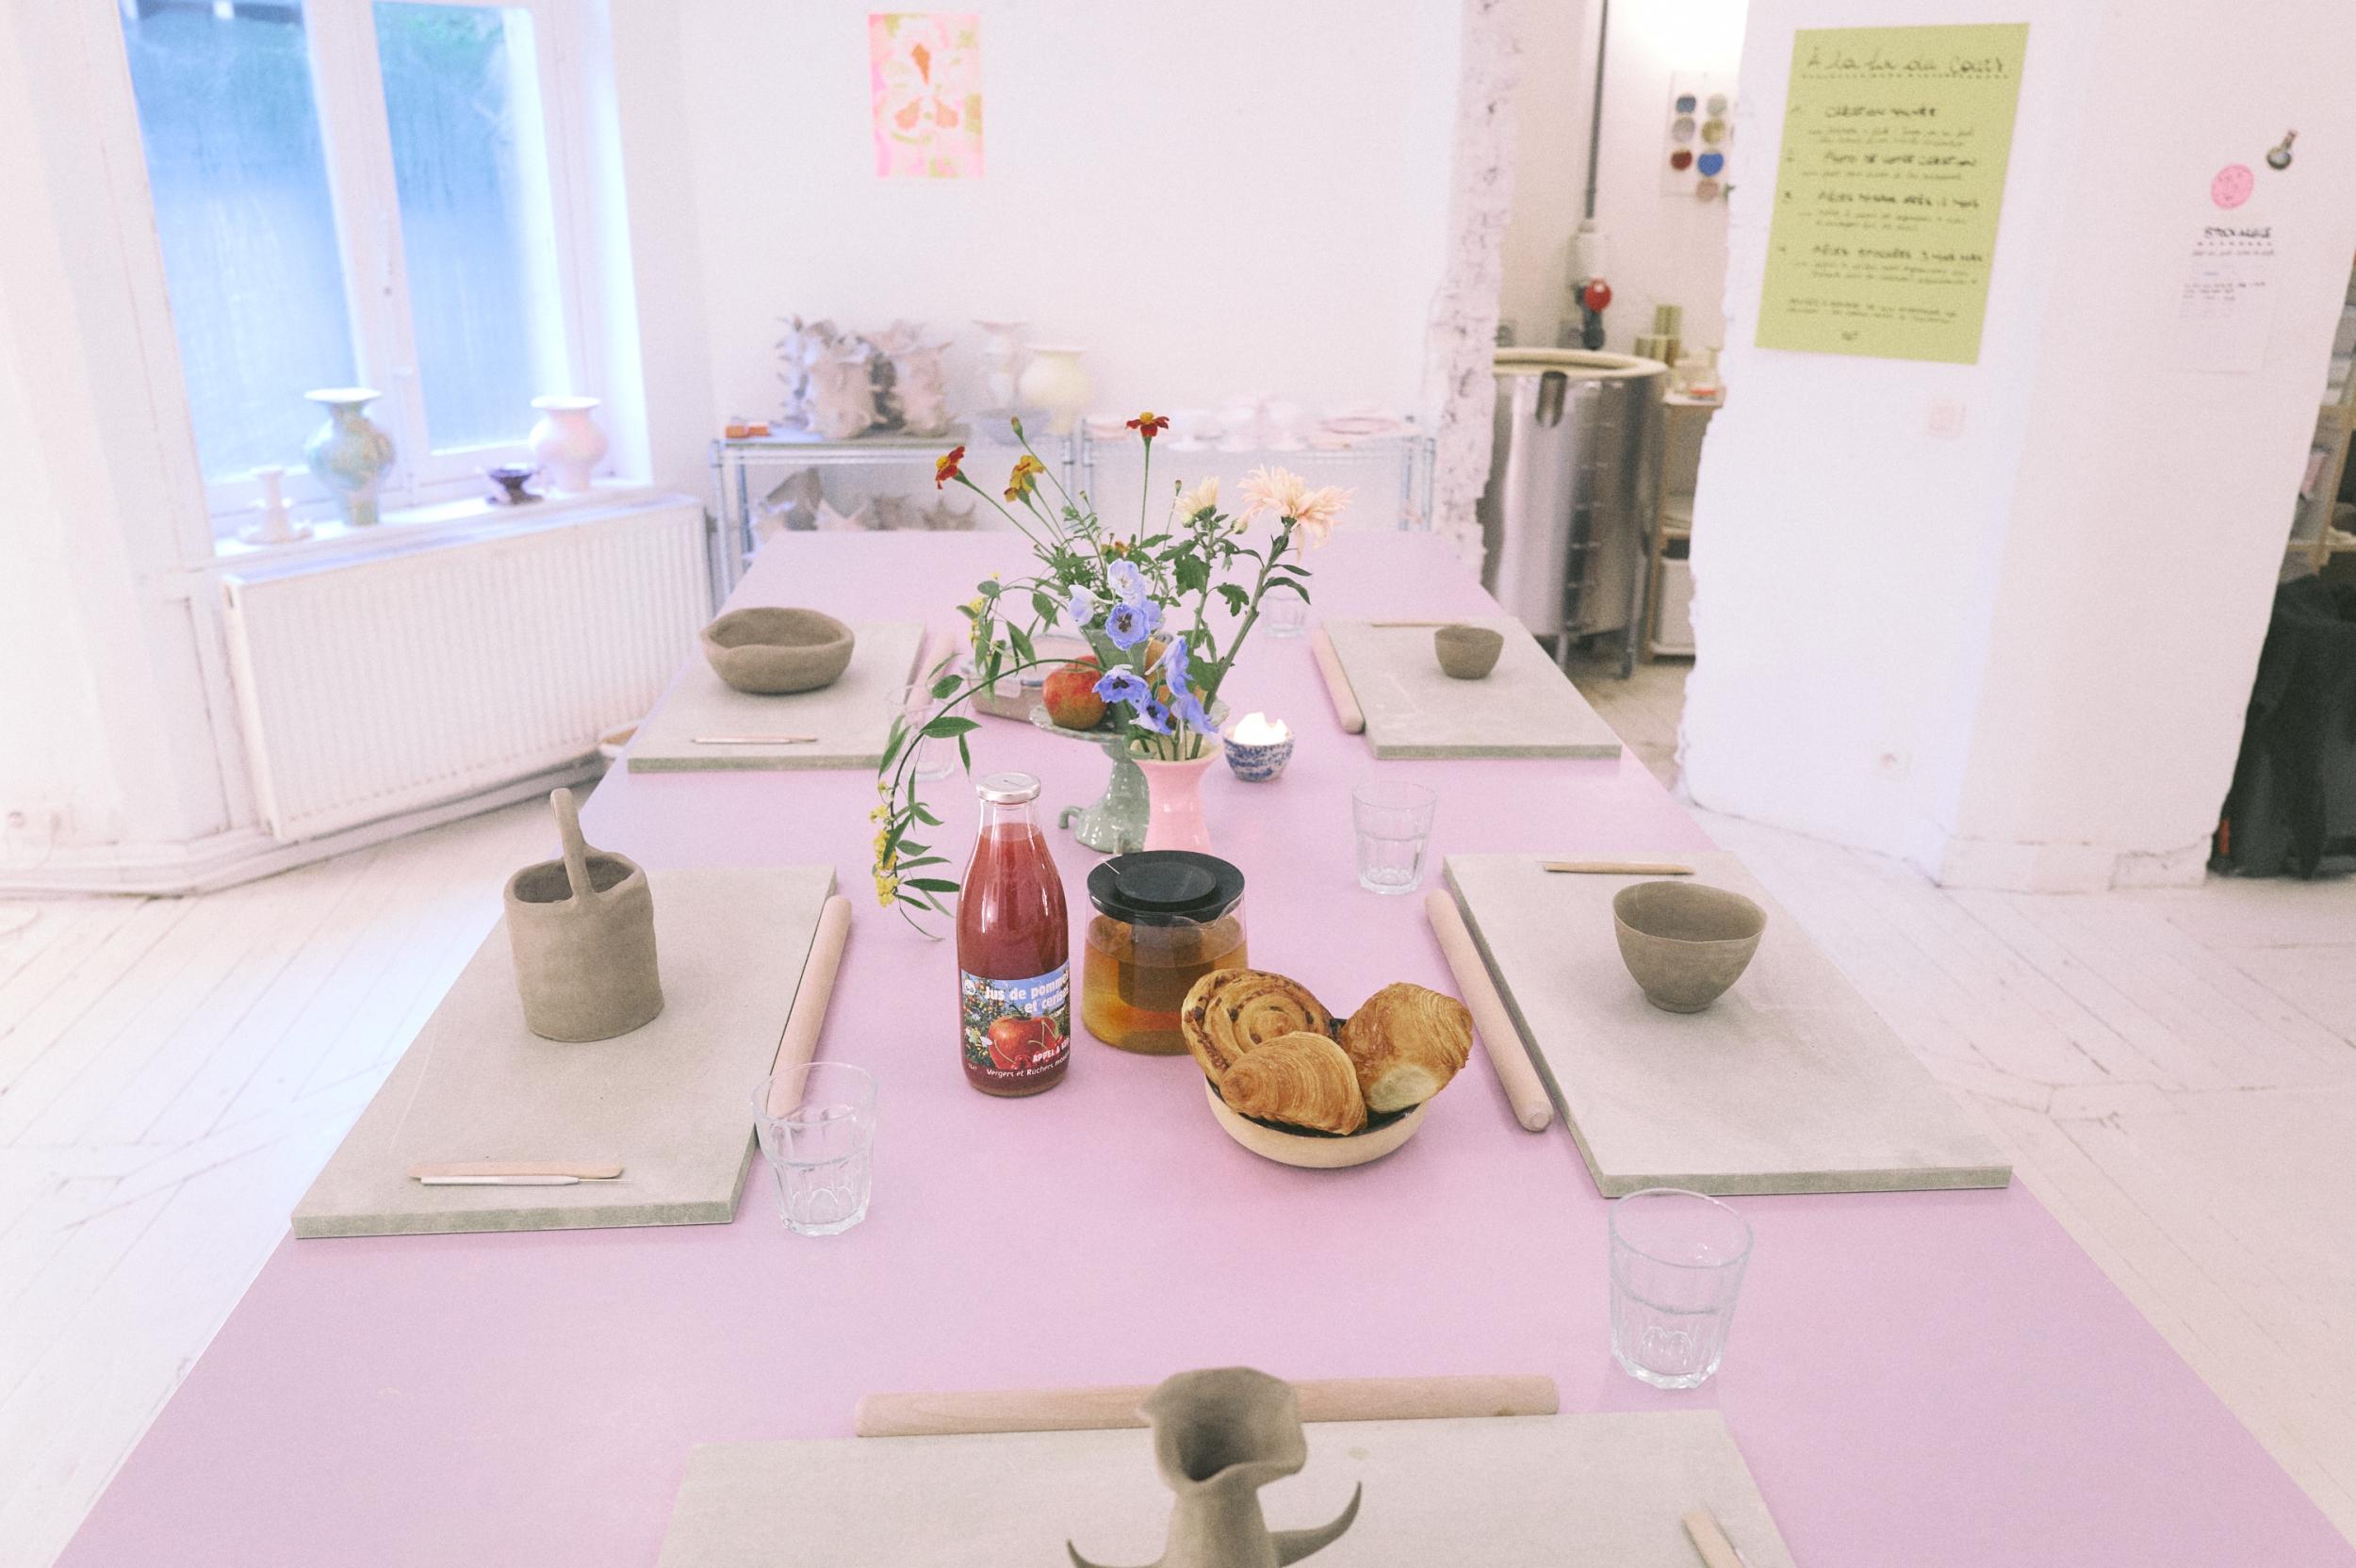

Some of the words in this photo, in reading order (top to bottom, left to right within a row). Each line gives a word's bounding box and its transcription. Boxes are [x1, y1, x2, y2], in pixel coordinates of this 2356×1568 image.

[985, 986, 1006, 1001] Jus
[1009, 988, 1026, 1001] de
[1024, 1002, 1038, 1014] et
[987, 1069, 1014, 1079] Vergers
[1026, 1063, 1055, 1076] Ruchers
